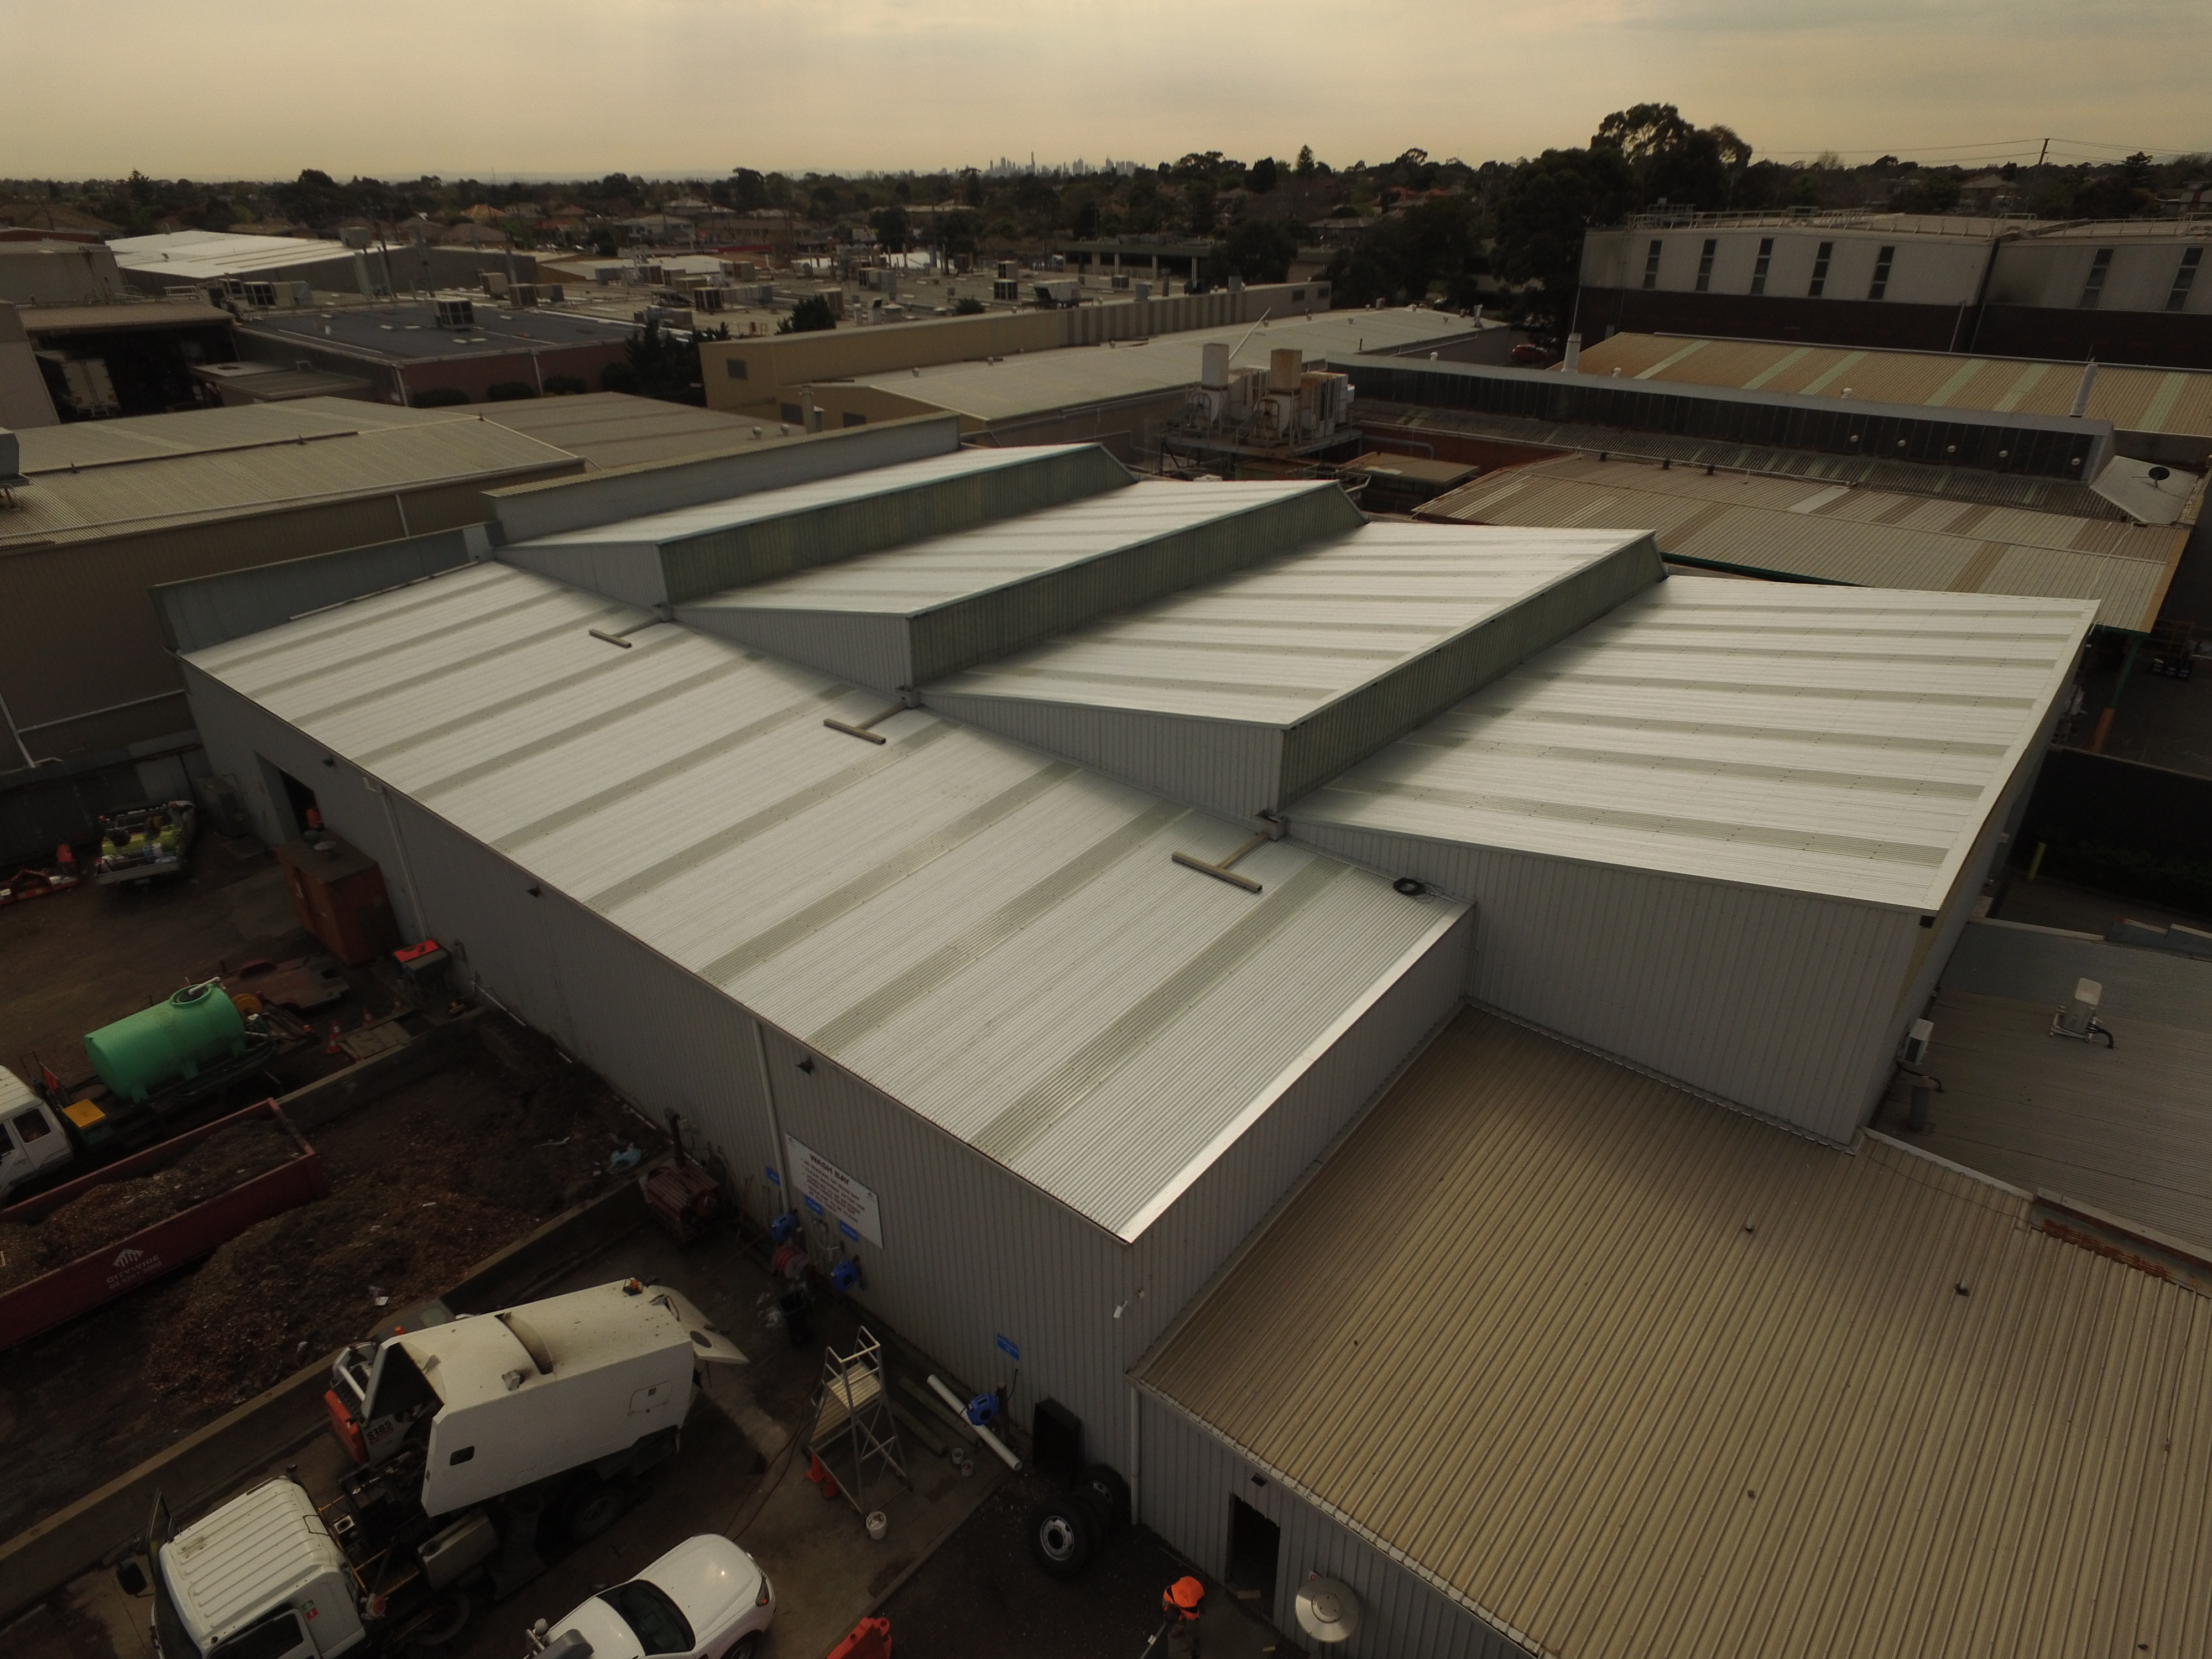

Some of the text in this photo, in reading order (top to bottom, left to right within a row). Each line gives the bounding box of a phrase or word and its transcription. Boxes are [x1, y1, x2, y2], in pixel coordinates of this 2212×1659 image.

[810, 1153, 832, 1173] WASH
[834, 1170, 849, 1185] BAY
[106, 1254, 160, 1283] CITYWIDE
[367, 1420, 392, 1441] S185
